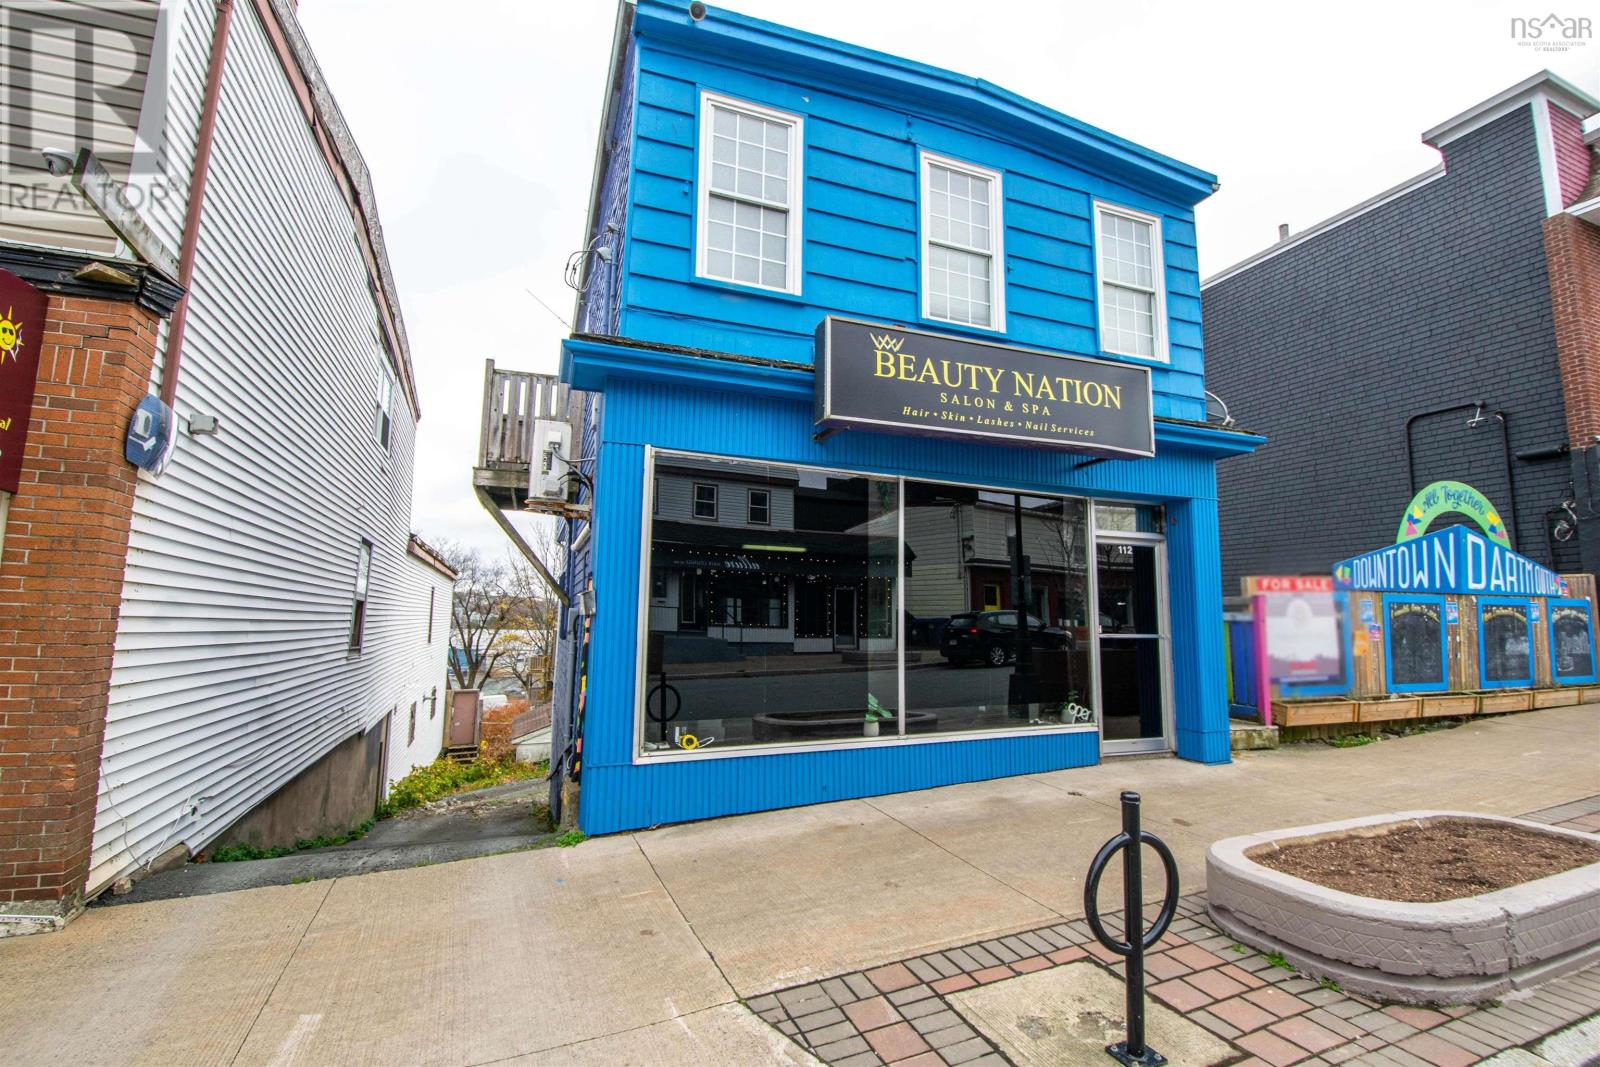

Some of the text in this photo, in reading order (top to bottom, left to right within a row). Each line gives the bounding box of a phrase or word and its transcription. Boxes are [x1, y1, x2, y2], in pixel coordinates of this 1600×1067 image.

[873, 349, 1122, 410] BEAUTY NATION
[940, 392, 1051, 416] SALON & SPA
[902, 406, 1096, 437] Hair Skin Lashes Nail Services
[1441, 486, 1485, 515] Together
[1118, 546, 1133, 555] 112
[1352, 532, 1555, 597] DOWNTOWN DARTMOUTH
[1262, 577, 1330, 592] FOR SALE
